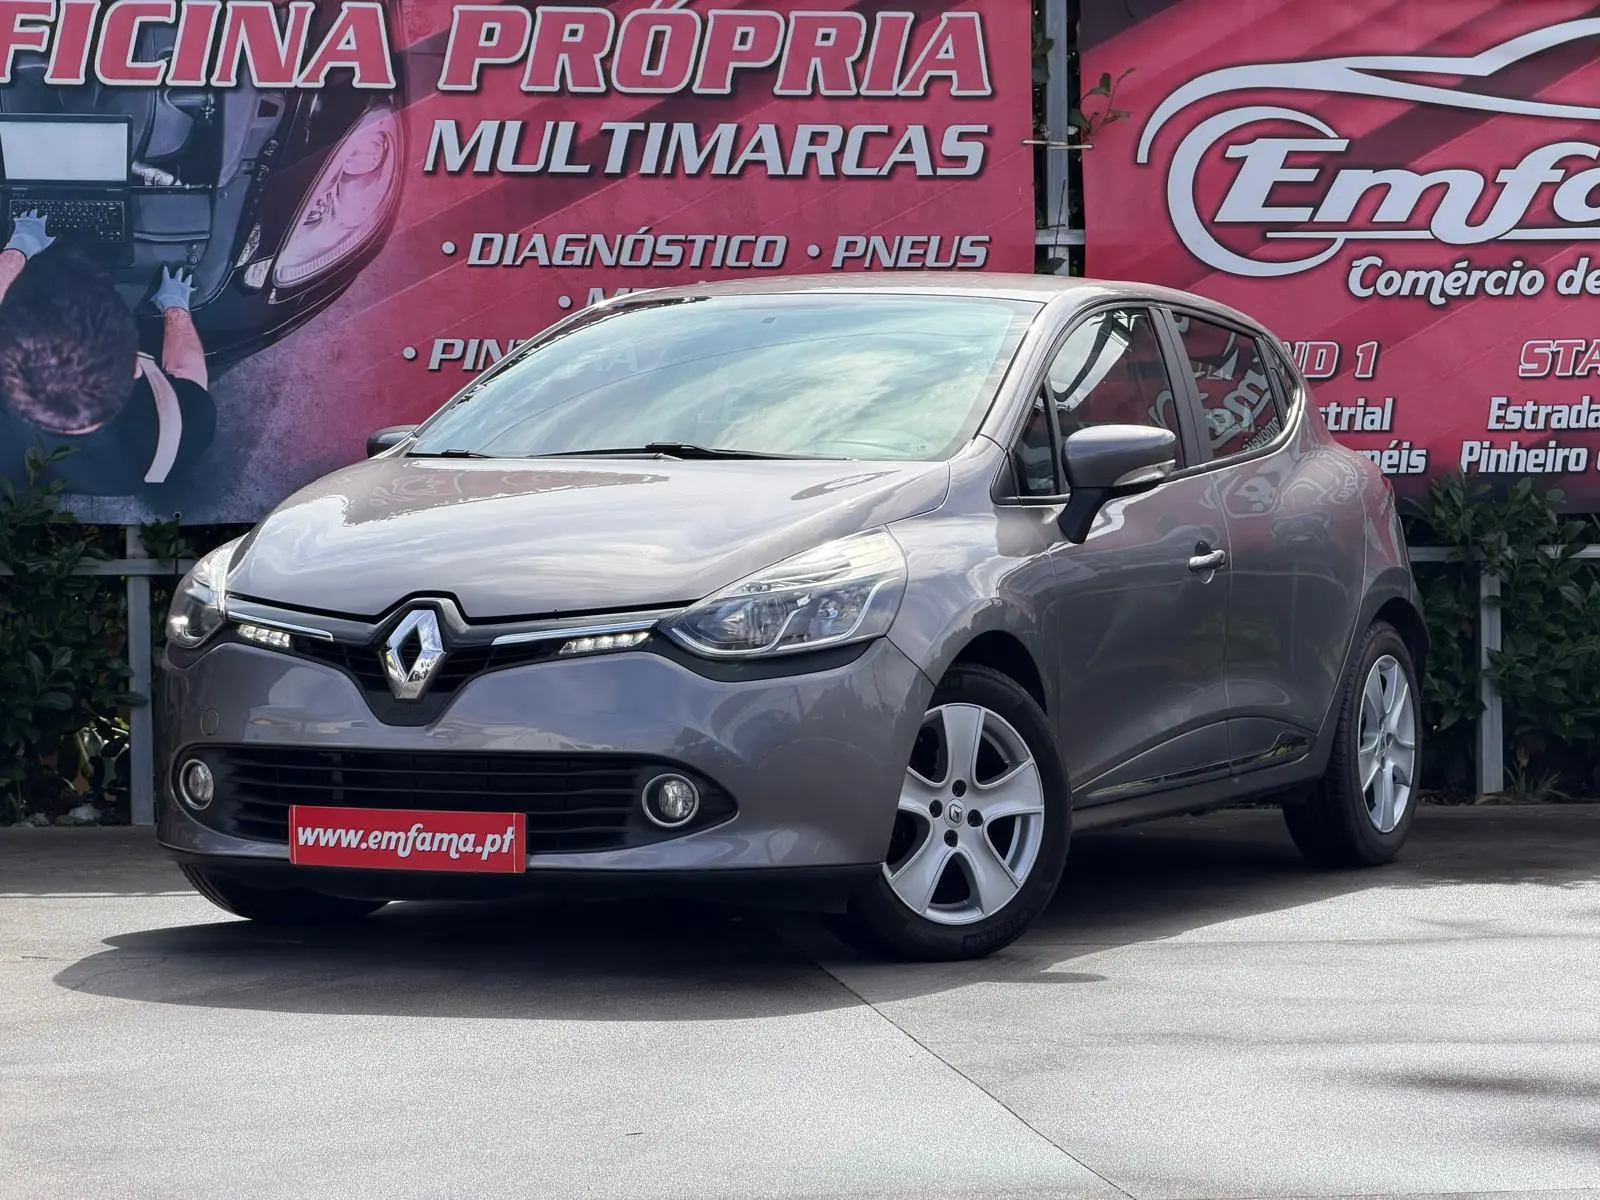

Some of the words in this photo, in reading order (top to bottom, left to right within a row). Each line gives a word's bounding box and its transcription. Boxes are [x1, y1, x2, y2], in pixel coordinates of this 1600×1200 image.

[0, 0, 395, 88] FICINA
[437, 0, 992, 97] PRÓPRIA
[424, 118, 989, 176] MULTIMARCAS
[467, 227, 787, 268] DIAGNÓSTICO
[831, 235, 990, 268] PNEUS
[1347, 256, 1546, 305] Comércio
[1556, 257, 1600, 296] de
[1355, 341, 1378, 378] 1
[1518, 339, 1600, 377] STA
[1487, 395, 1600, 430] Estrada
[1460, 440, 1588, 473] Pinheiro
[298, 823, 515, 861] www.emfama.pt
